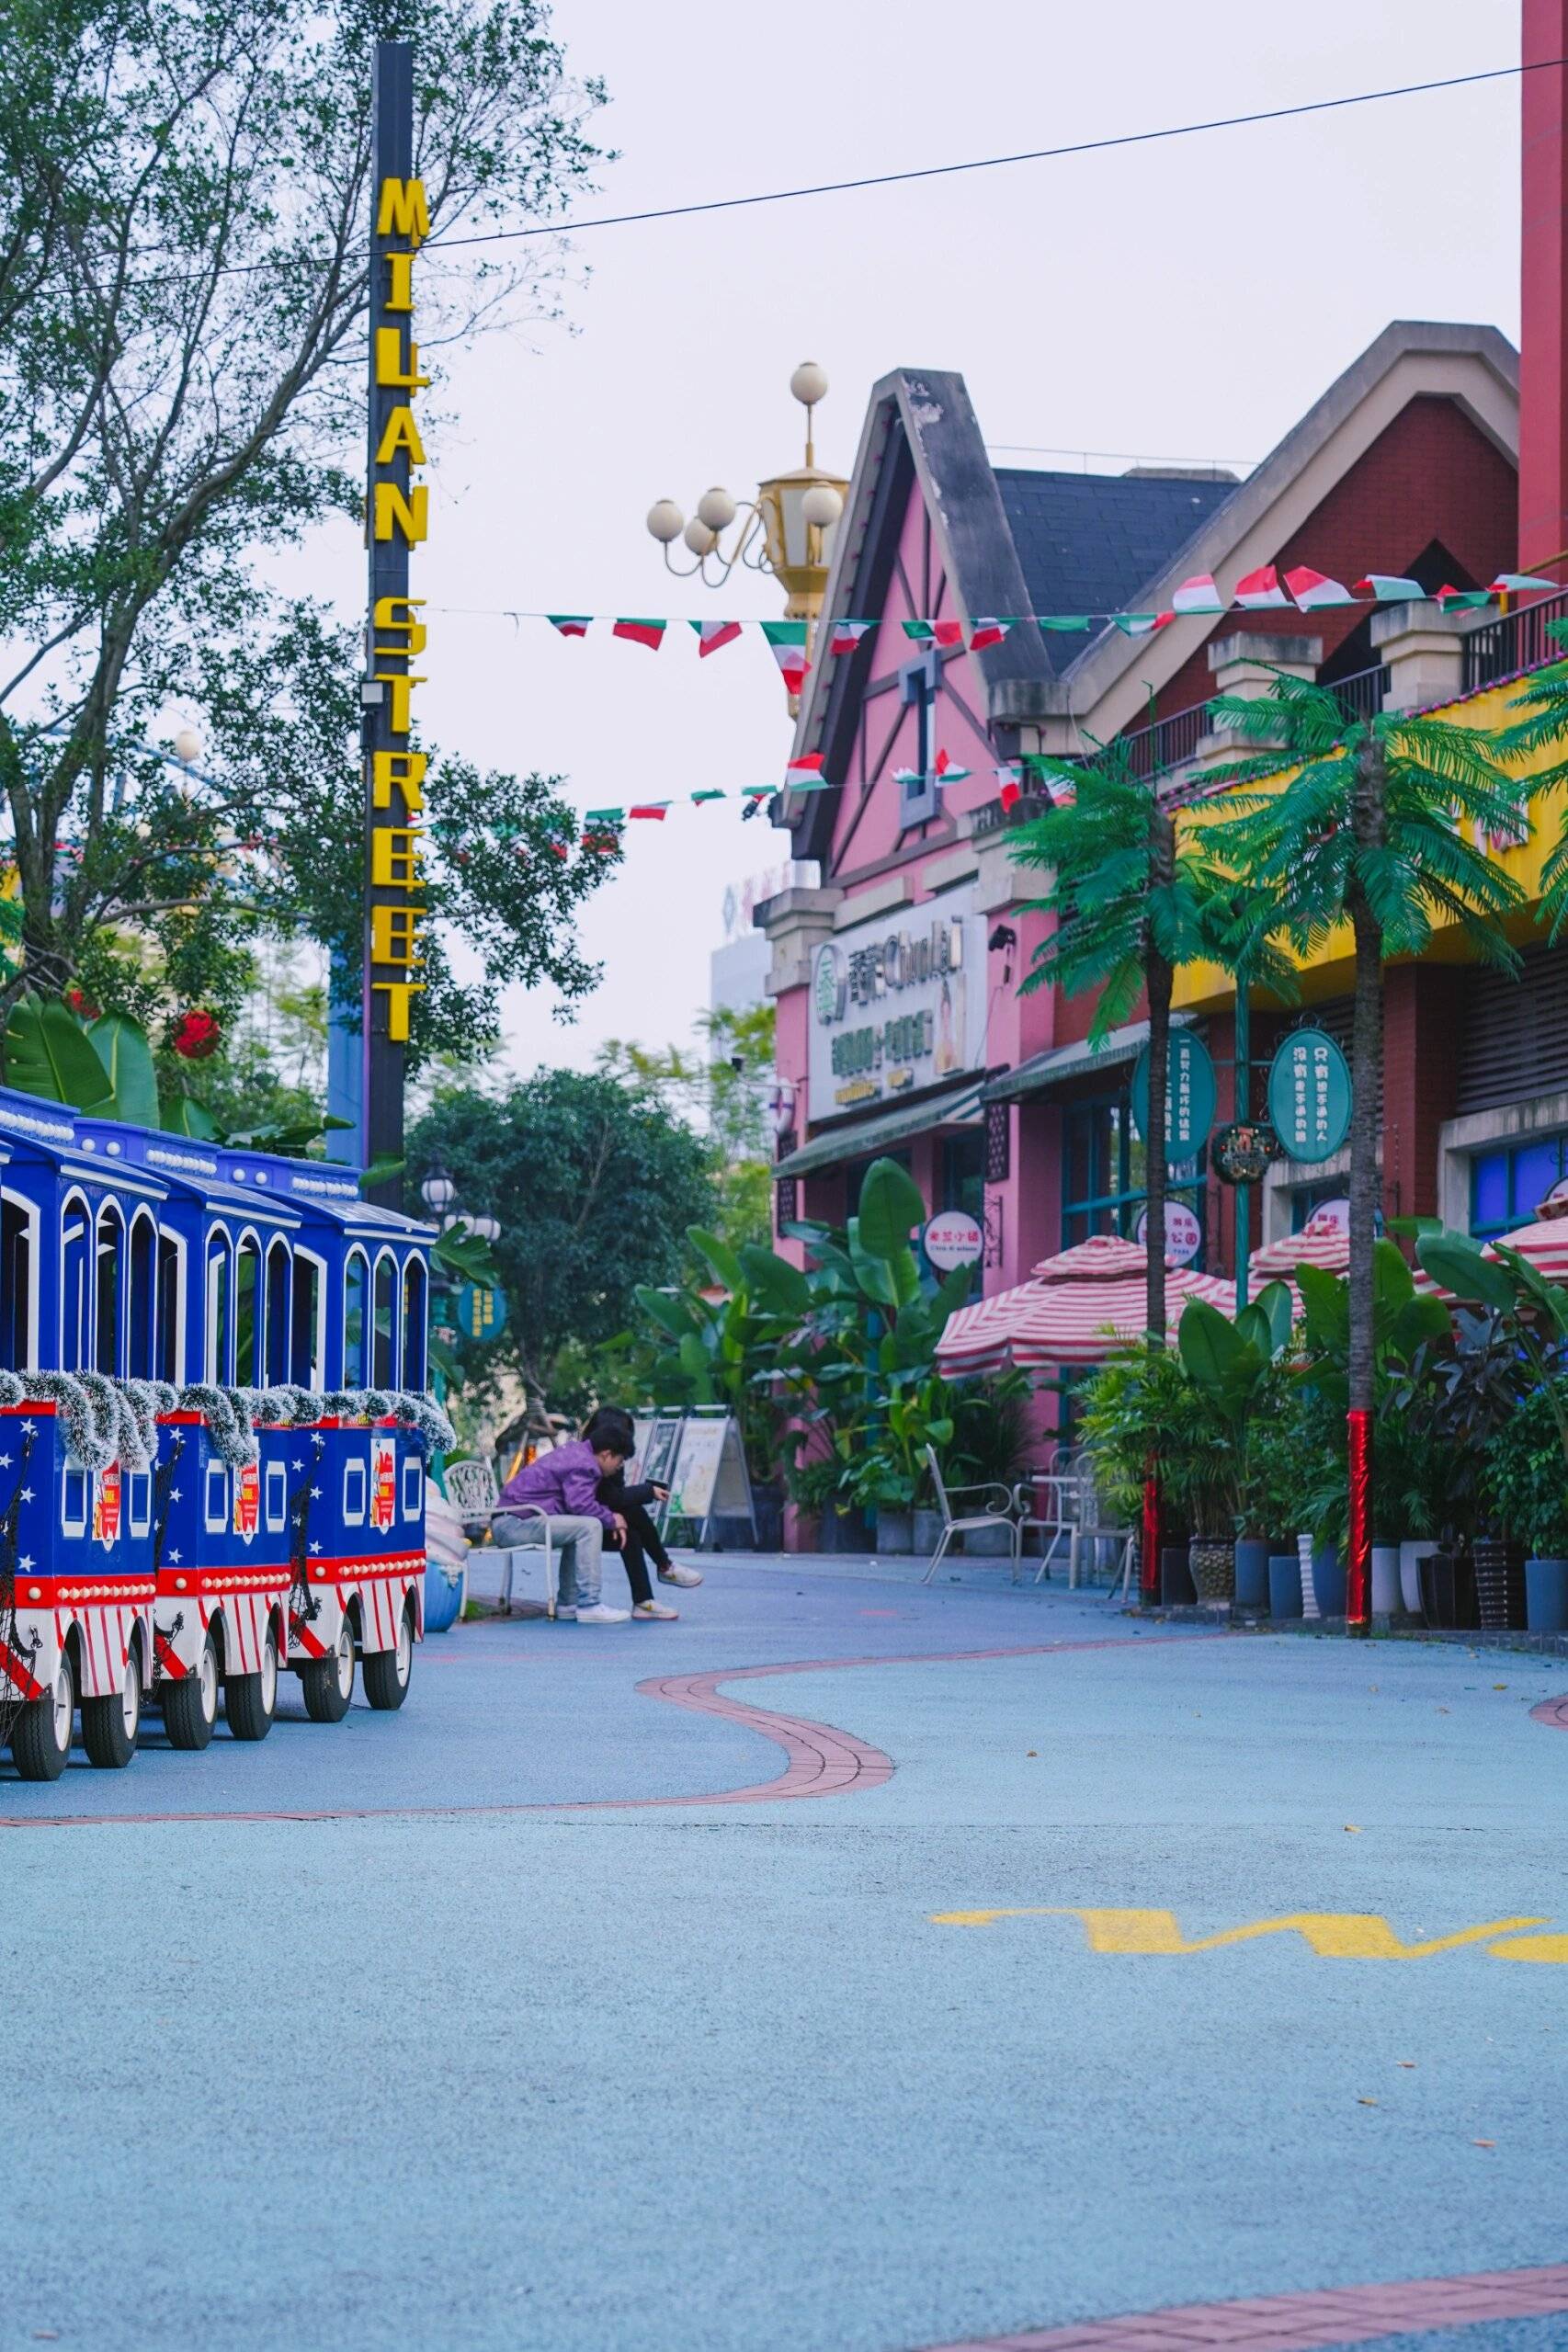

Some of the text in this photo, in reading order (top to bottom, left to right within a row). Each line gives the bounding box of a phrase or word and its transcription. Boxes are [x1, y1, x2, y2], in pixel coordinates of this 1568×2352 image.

[374, 177, 430, 543] MILAN
[370, 597, 428, 1043] STREET
[1313, 1046, 1329, 1142] 只有想不通的人
